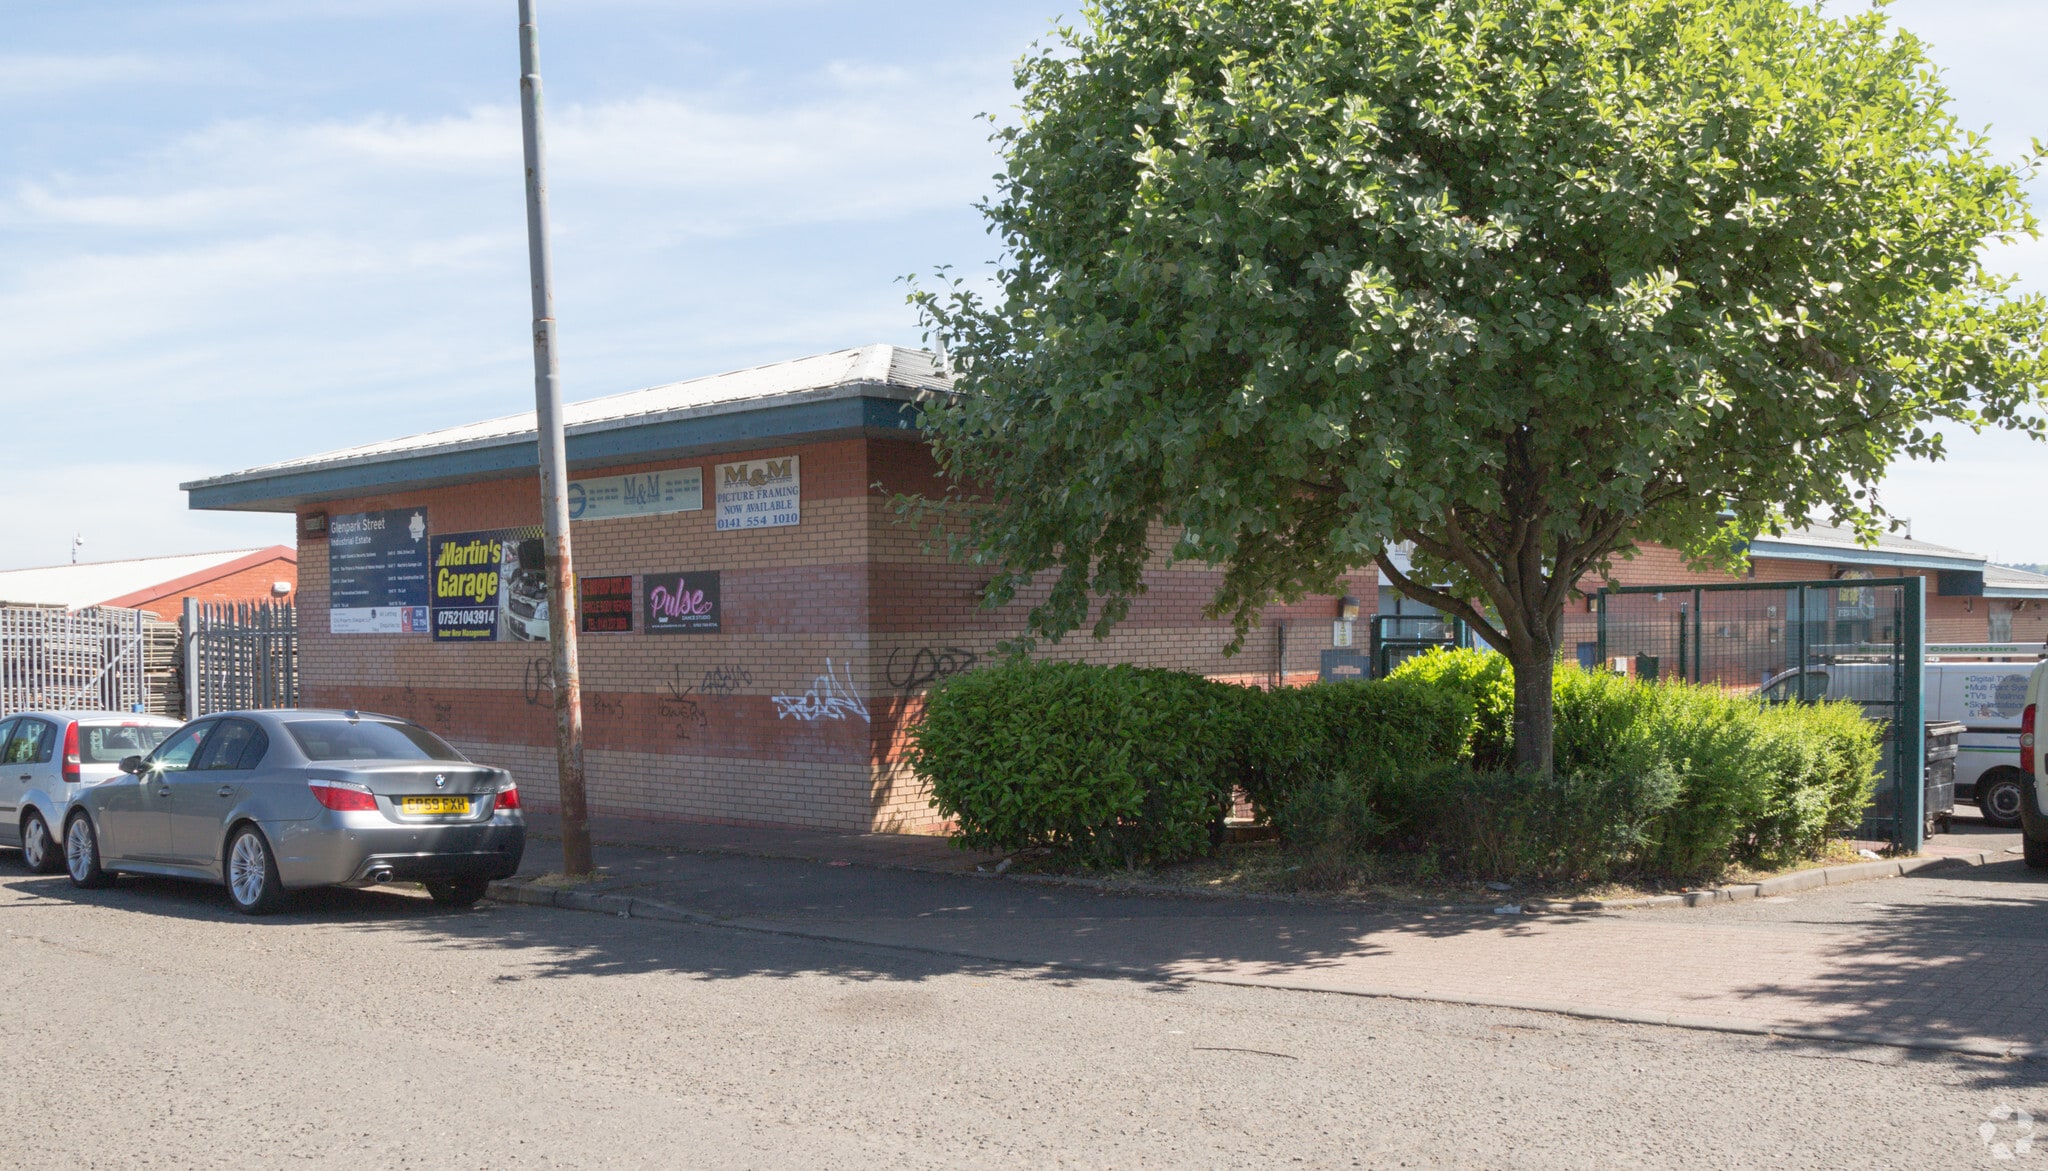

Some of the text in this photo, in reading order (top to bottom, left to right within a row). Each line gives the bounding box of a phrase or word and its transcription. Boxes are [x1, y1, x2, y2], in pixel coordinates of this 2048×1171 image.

[724, 460, 792, 486] M&M
[624, 474, 660, 505] M&M
[717, 486, 799, 503] PICTURE FRAMING
[724, 499, 793, 515] NOW AVAILABLE
[331, 517, 386, 534] Glenpark Street
[717, 513, 798, 529] 0141 554 1010
[331, 536, 371, 546] Industrial Estate
[435, 539, 501, 566] Martin's
[437, 567, 499, 603] Garage
[650, 577, 706, 618] Pulse
[438, 610, 495, 625] 07521043914
[461, 628, 490, 638] Management
[1970, 675, 1994, 683] Digital
[442, 797, 465, 810] FXH
